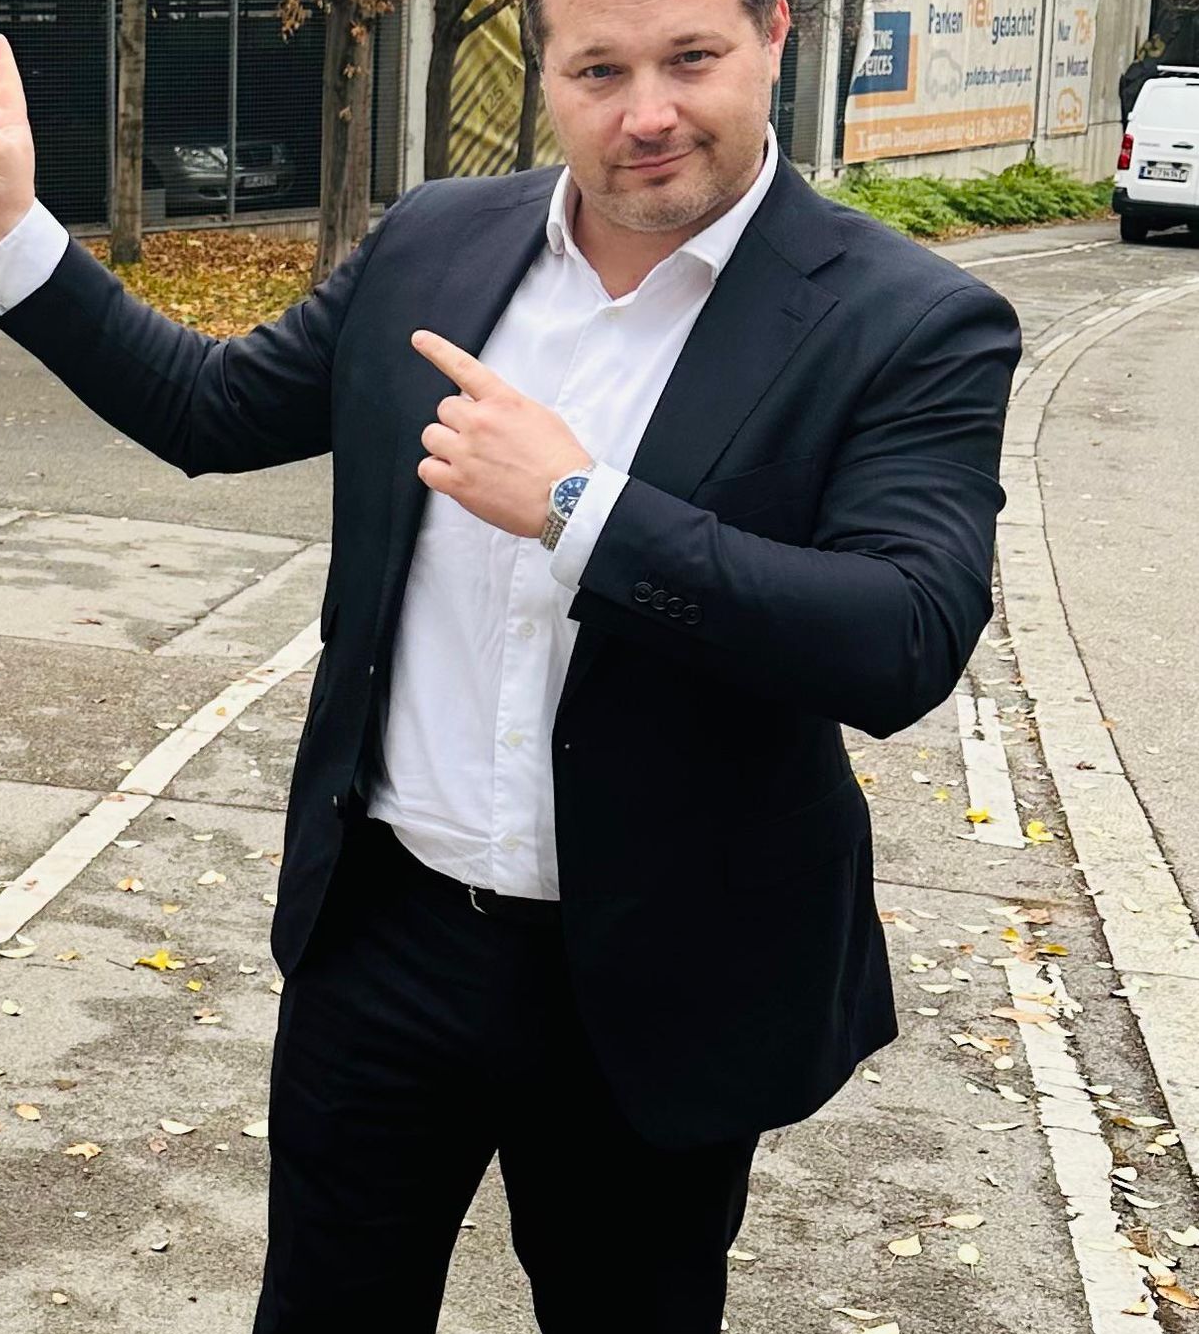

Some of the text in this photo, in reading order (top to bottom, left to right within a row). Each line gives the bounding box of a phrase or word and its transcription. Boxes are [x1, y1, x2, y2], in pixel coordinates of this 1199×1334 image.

[928, 3, 963, 34] Parken
[991, 7, 1036, 45] gedacht!
[1058, 19, 1071, 41] Nur
[1066, 54, 1089, 77] Monat
[479, 85, 505, 116] 125
